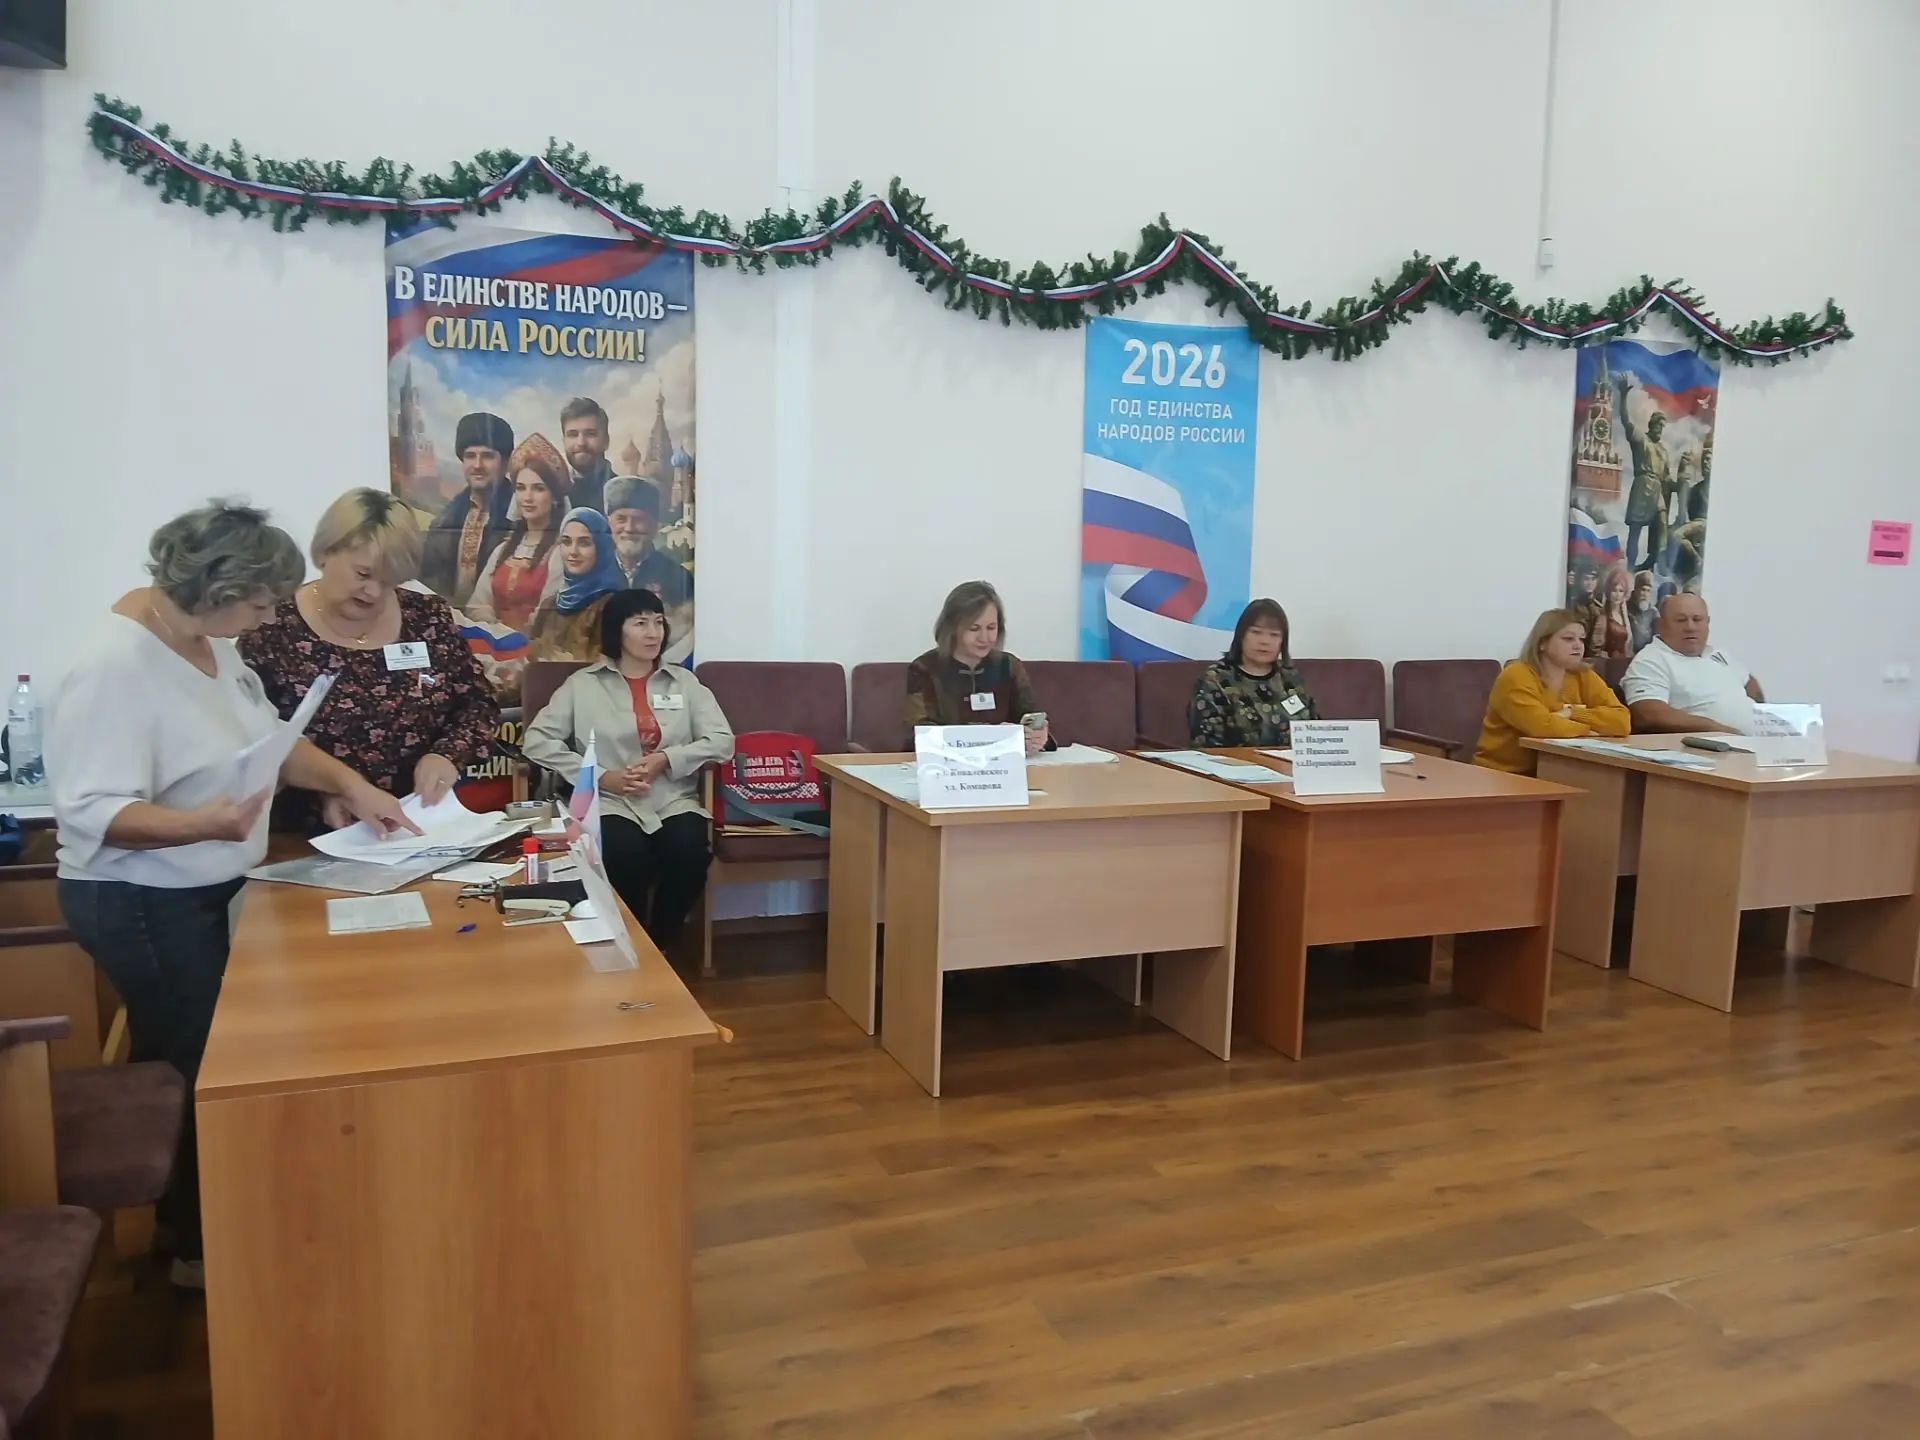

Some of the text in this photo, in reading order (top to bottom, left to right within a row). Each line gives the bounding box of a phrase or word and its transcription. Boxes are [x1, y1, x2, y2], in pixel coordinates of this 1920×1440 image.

[394, 265, 415, 300] В
[423, 272, 549, 311] ЕДИНСТВЕ
[425, 315, 646, 362] СИЛА РОССИИ!
[1121, 338, 1226, 389] 2026
[1110, 399, 1233, 419] ГОД ЕДИНСТВА
[1097, 423, 1245, 443] НАРОДОВ РОССИИ
[960, 782, 1001, 791] Комарова
